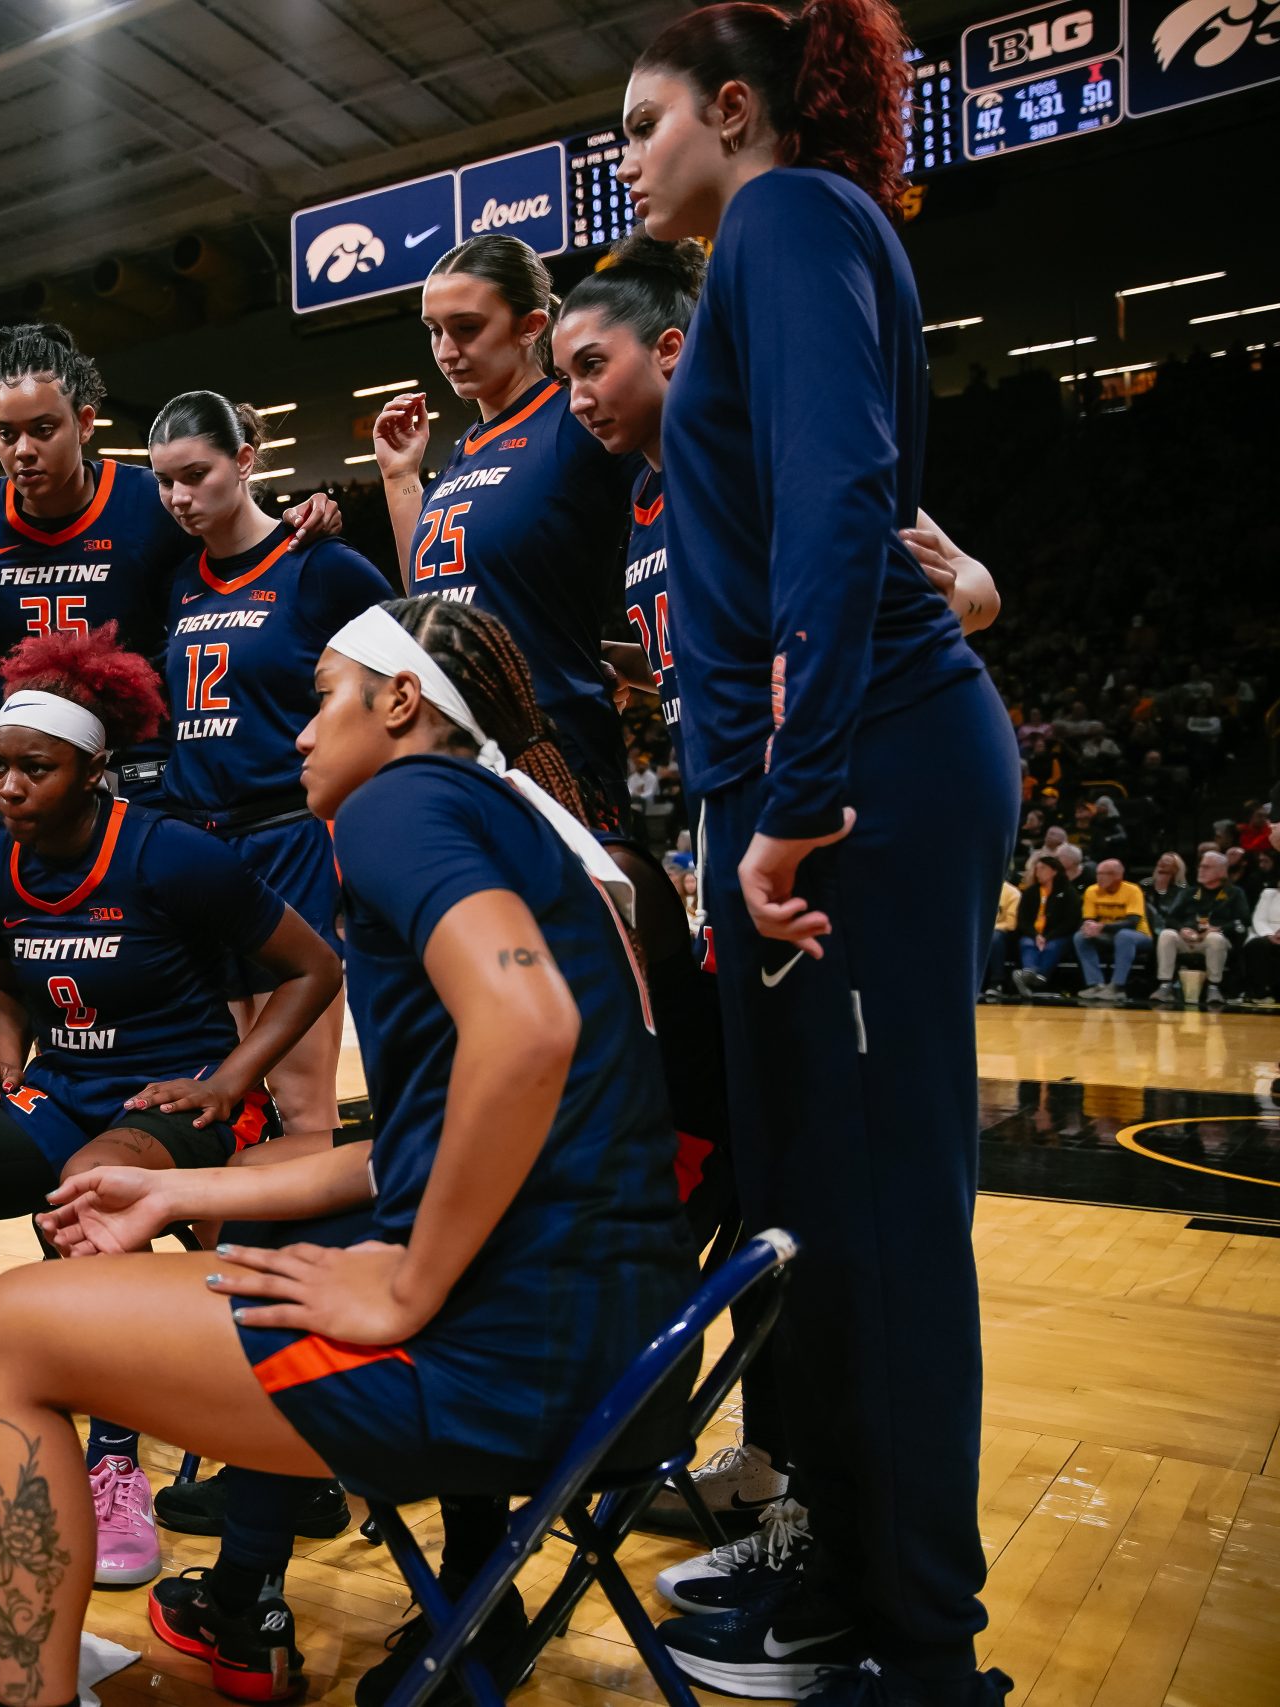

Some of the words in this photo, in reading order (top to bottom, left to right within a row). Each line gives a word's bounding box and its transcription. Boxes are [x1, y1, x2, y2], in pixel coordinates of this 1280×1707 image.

[1082, 79, 1112, 106] 50
[977, 107, 1004, 131] 47
[1019, 92, 1066, 122] 4:31
[587, 131, 616, 147] IOWA
[1029, 119, 1058, 141] 3RD
[471, 193, 552, 233] Iowa
[415, 501, 472, 582] 25
[0, 564, 111, 586] FIGHTING
[20, 595, 89, 641] 35
[174, 610, 270, 637] FIGHTING
[185, 642, 230, 711] 12
[176, 718, 239, 741] ILLINI
[14, 935, 122, 960] FIGHTING
[51, 1027, 116, 1050] ILLINI
